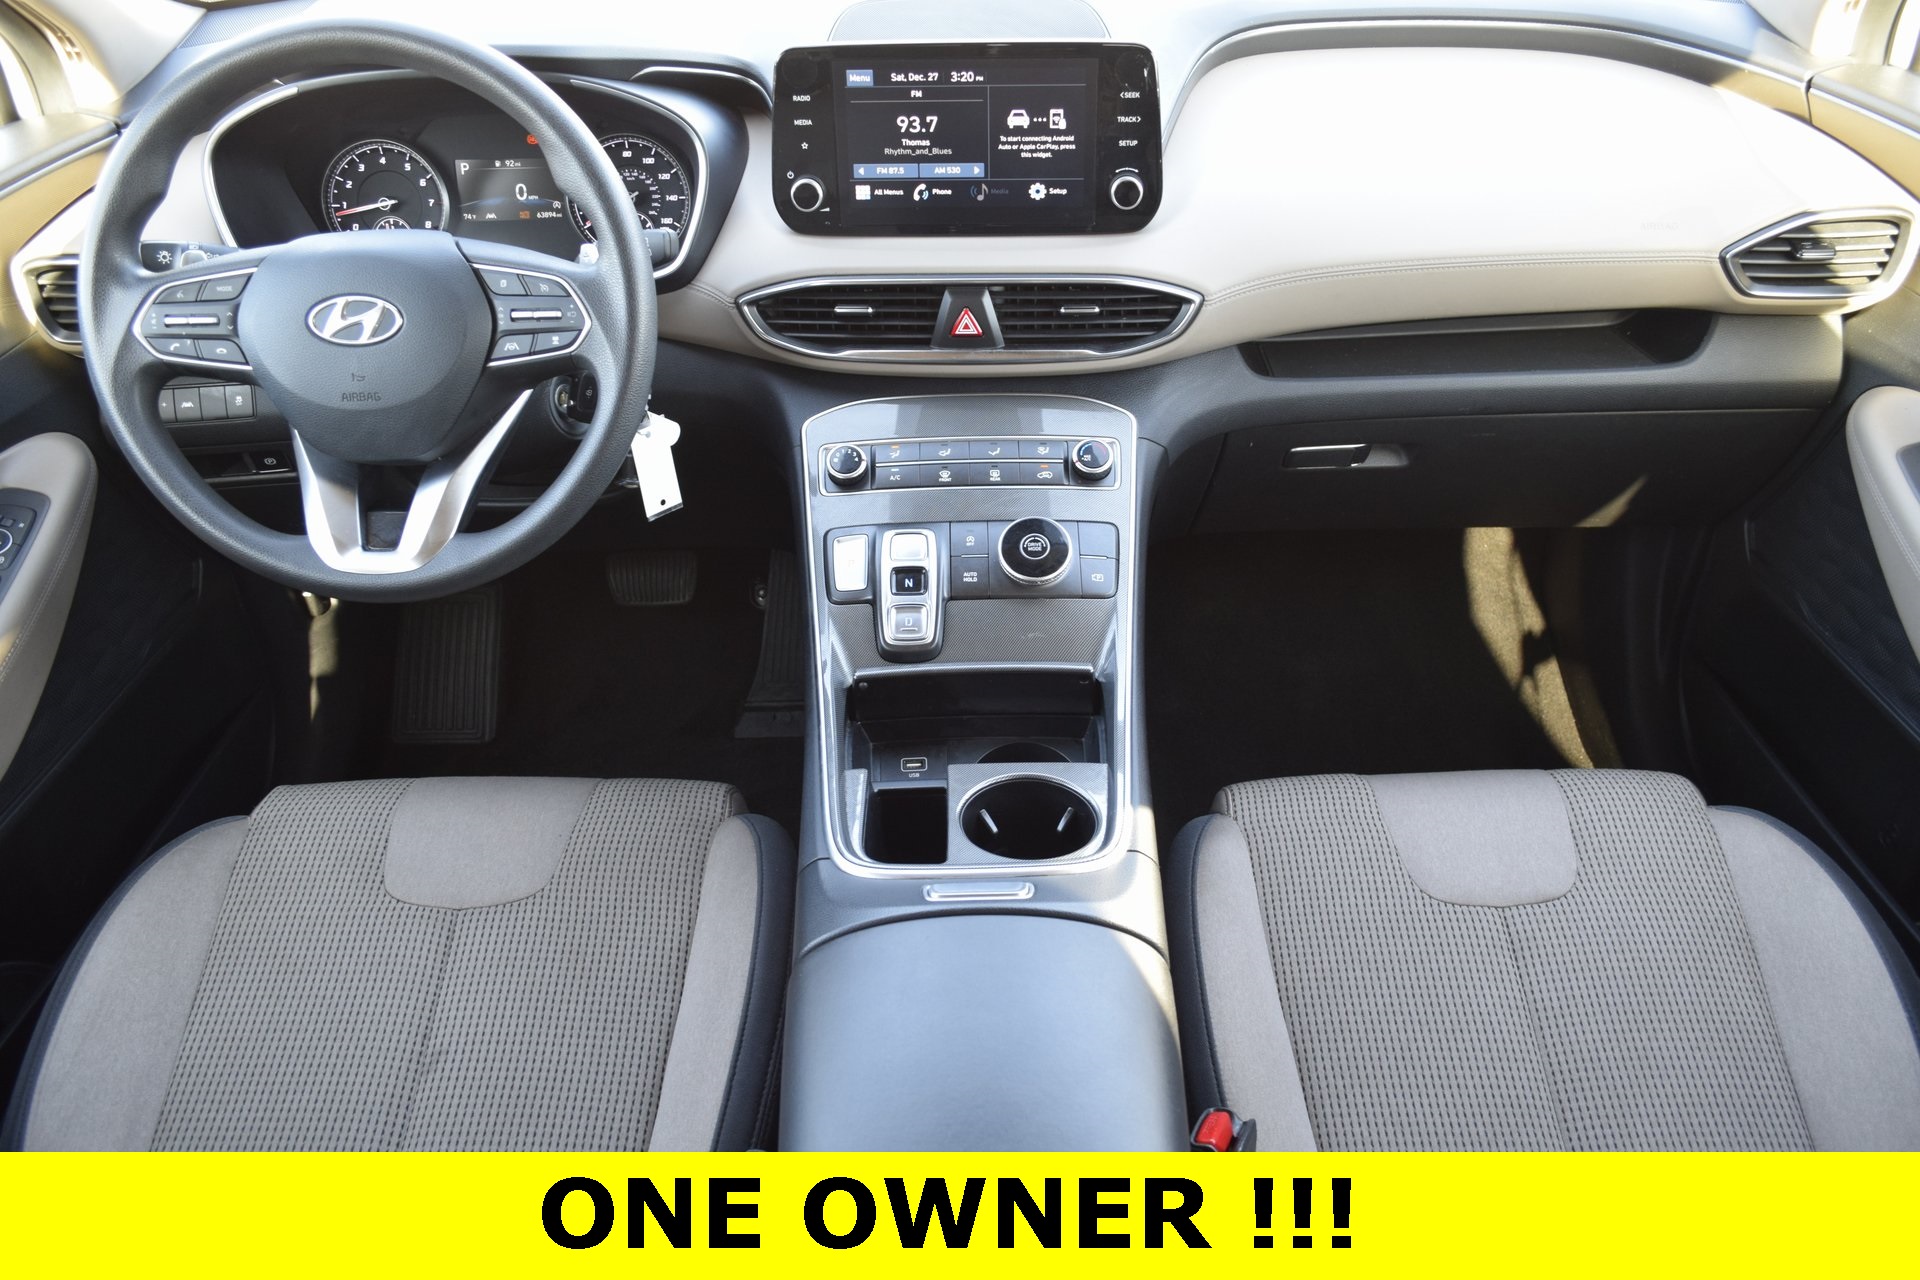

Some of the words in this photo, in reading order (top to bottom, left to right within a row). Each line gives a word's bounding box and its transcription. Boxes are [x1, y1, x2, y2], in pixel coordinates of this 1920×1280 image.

[849, 74, 871, 82] Menu
[908, 72, 926, 82] Dec.
[928, 72, 939, 82] 27
[950, 71, 974, 82] 3:20
[910, 90, 922, 98] FM
[896, 115, 938, 133] 93.7
[901, 138, 931, 146] Thomas
[884, 147, 953, 156] Rhythm_and_Blues
[379, 156, 386, 165] 4
[358, 163, 365, 172] 3
[404, 163, 411, 171] 5
[460, 162, 470, 175] P
[876, 167, 887, 175] FM
[947, 166, 961, 174] 530
[419, 178, 427, 187] 6
[515, 183, 527, 201] 0
[1049, 187, 1068, 196] Setup
[342, 201, 347, 209] 1
[428, 199, 435, 207] 7
[425, 221, 432, 229] 8
[341, 392, 382, 402] AIRBAG
[904, 578, 914, 588] N
[904, 617, 913, 627] D
